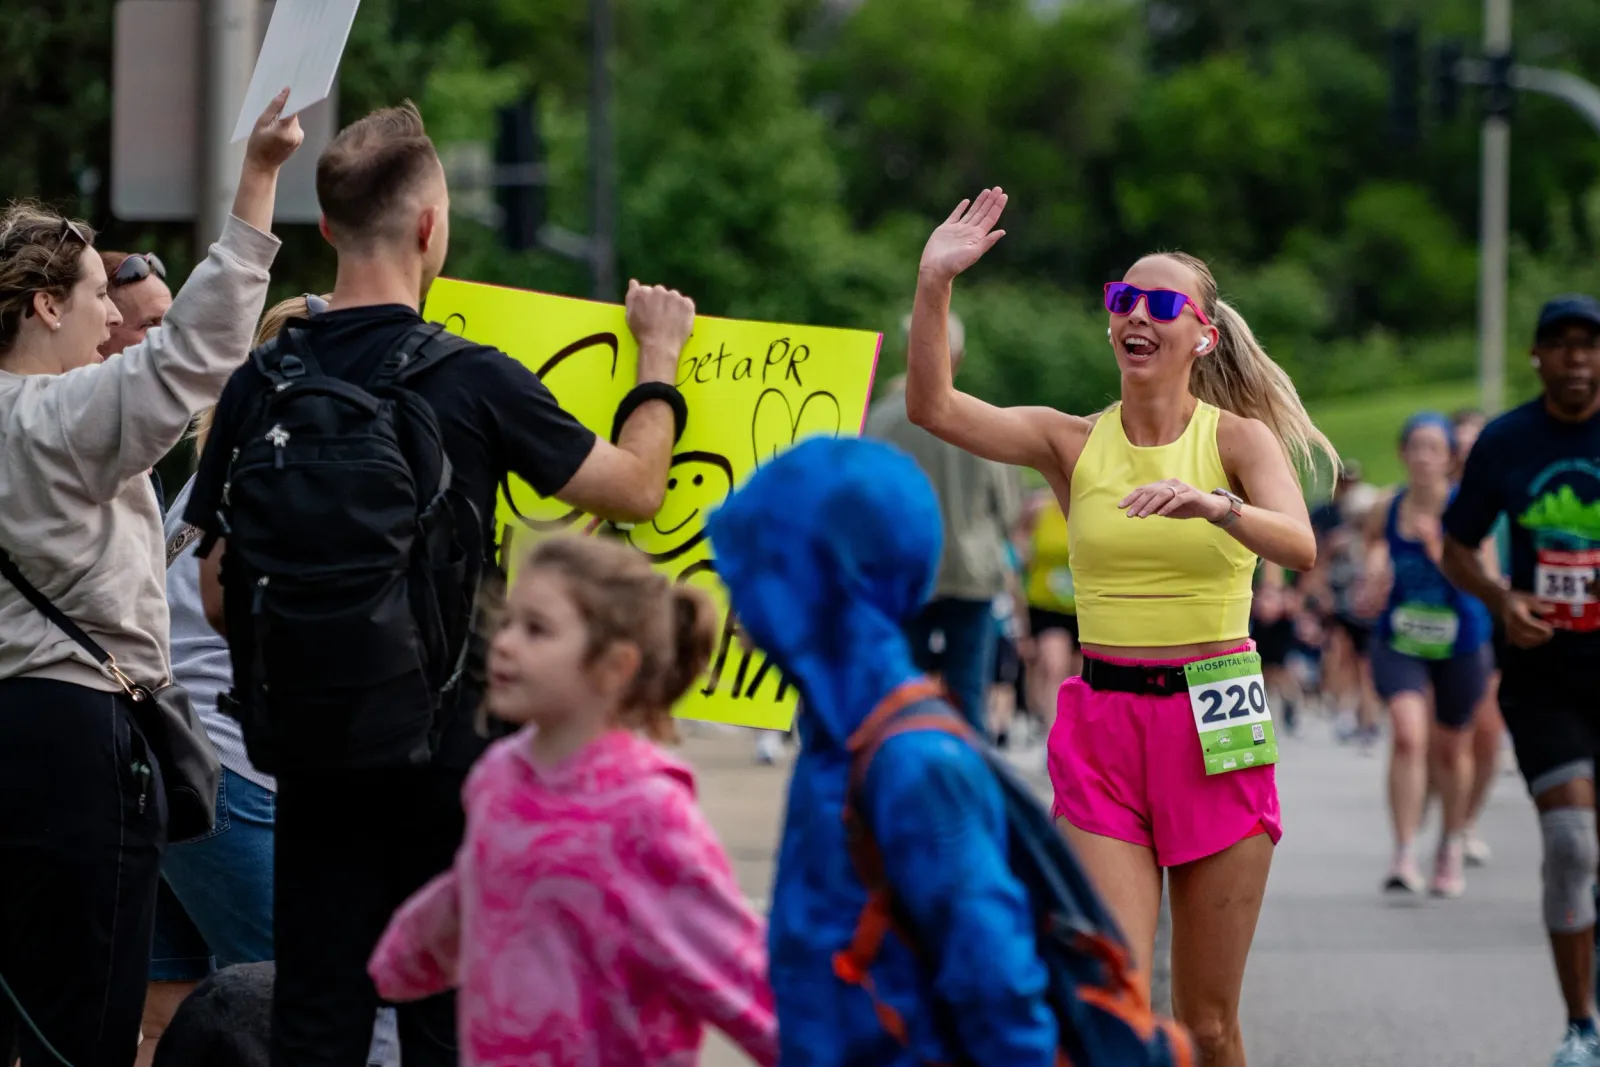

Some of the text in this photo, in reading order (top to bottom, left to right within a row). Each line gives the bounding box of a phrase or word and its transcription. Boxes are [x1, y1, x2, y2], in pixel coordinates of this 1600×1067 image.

[762, 337, 810, 387] PR
[1196, 658, 1242, 673] HOSPITAL
[1198, 681, 1265, 724] 220
